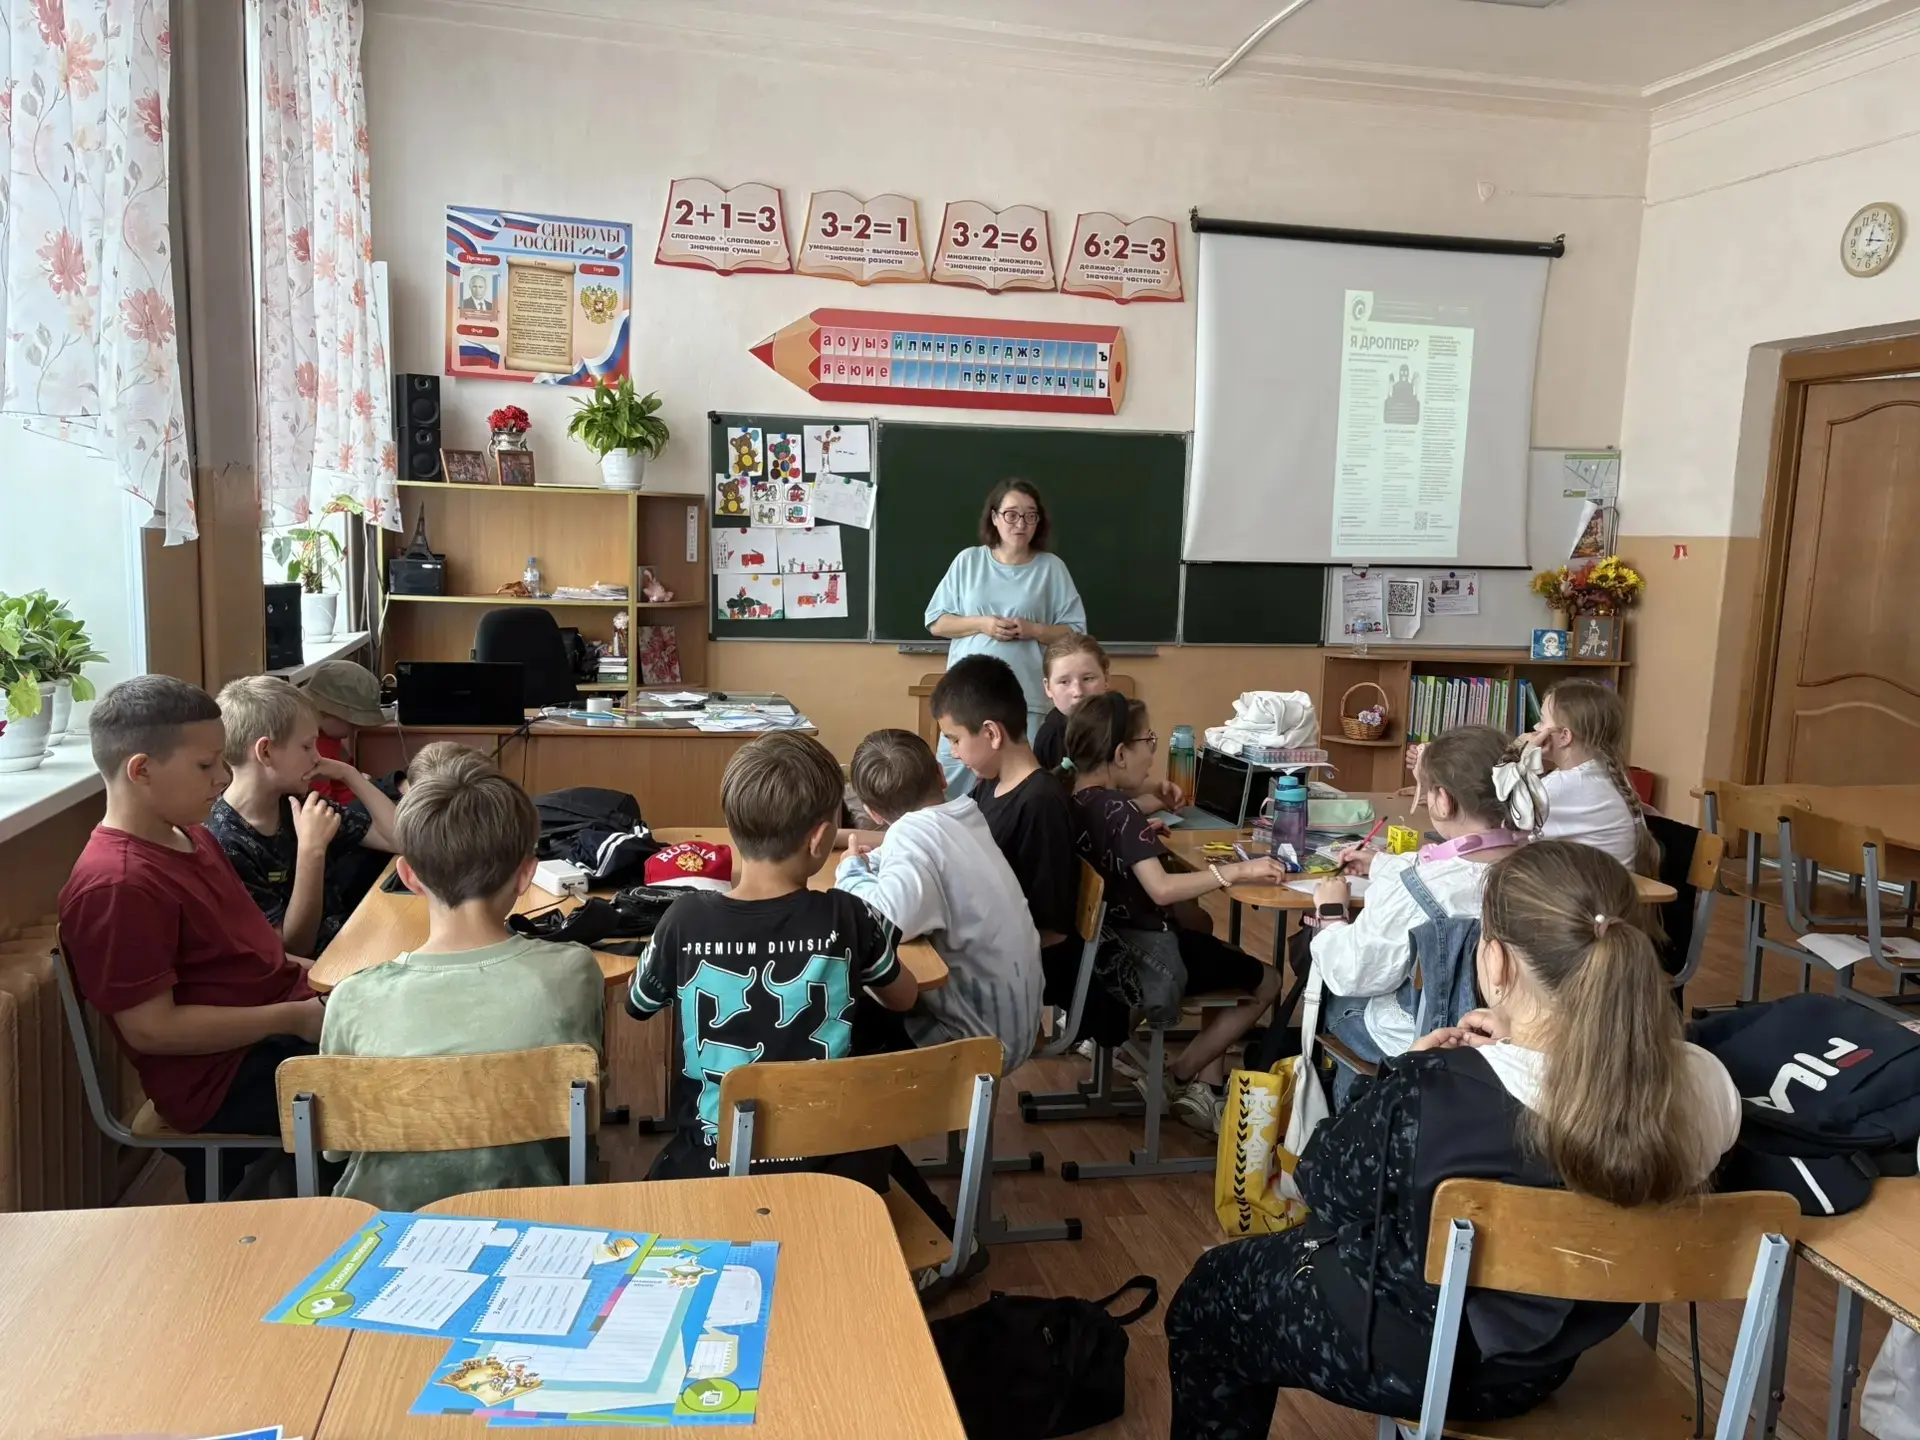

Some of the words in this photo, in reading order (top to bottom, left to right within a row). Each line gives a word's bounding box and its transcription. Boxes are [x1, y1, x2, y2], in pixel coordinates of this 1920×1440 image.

[675, 199, 777, 233] 2+1=3
[541, 222, 621, 244] СИМВОЛЫ
[821, 211, 908, 242] 3-2=1
[513, 234, 575, 253] РОССИИ
[671, 233, 716, 242] слагаемое
[726, 237, 771, 246] слагаемое
[1084, 233, 1166, 263] 6:2=3
[689, 243, 729, 252] значение
[732, 246, 760, 255] суммы
[808, 243, 864, 253] уменьшаемое
[872, 247, 919, 257] вычитаемое
[868, 256, 903, 266] разности
[946, 253, 991, 262] множитель
[998, 257, 1042, 266] множитель
[989, 265, 1044, 275] произведения
[1079, 264, 1115, 273] делимое
[1123, 267, 1160, 276] делитель
[1085, 273, 1124, 282] значение
[1126, 275, 1161, 285] частного
[823, 335, 831, 346] а
[838, 336, 845, 347] о
[852, 336, 860, 352] у
[865, 337, 875, 349] ы
[880, 338, 888, 349] э
[895, 335, 903, 350] й
[908, 340, 917, 351] л
[922, 341, 931, 351] м
[937, 342, 944, 352] н
[950, 342, 958, 356] р
[964, 341, 972, 354] б
[978, 344, 985, 355] в
[992, 345, 998, 356] г
[1004, 346, 1013, 359] д
[1017, 347, 1028, 358] ж
[1032, 348, 1040, 358] з
[1099, 351, 1108, 362] ъ
[1350, 335, 1357, 348] Я
[1359, 336, 1419, 352] ДРОППЕР?
[823, 363, 831, 374] я
[838, 361, 845, 374] ё
[850, 365, 861, 376] ю
[866, 366, 874, 377] и
[880, 367, 888, 377] е
[964, 371, 971, 382] п
[975, 370, 986, 386] ф
[991, 373, 998, 384] к
[1005, 374, 1011, 384] т
[1017, 374, 1026, 385] ш
[1031, 375, 1039, 385] с
[1044, 376, 1052, 386] х
[1058, 376, 1066, 389] ц
[1072, 377, 1079, 387] ч
[1084, 378, 1093, 391] щ
[1099, 379, 1105, 389] ь
[656, 843, 718, 863] RUSSIA
